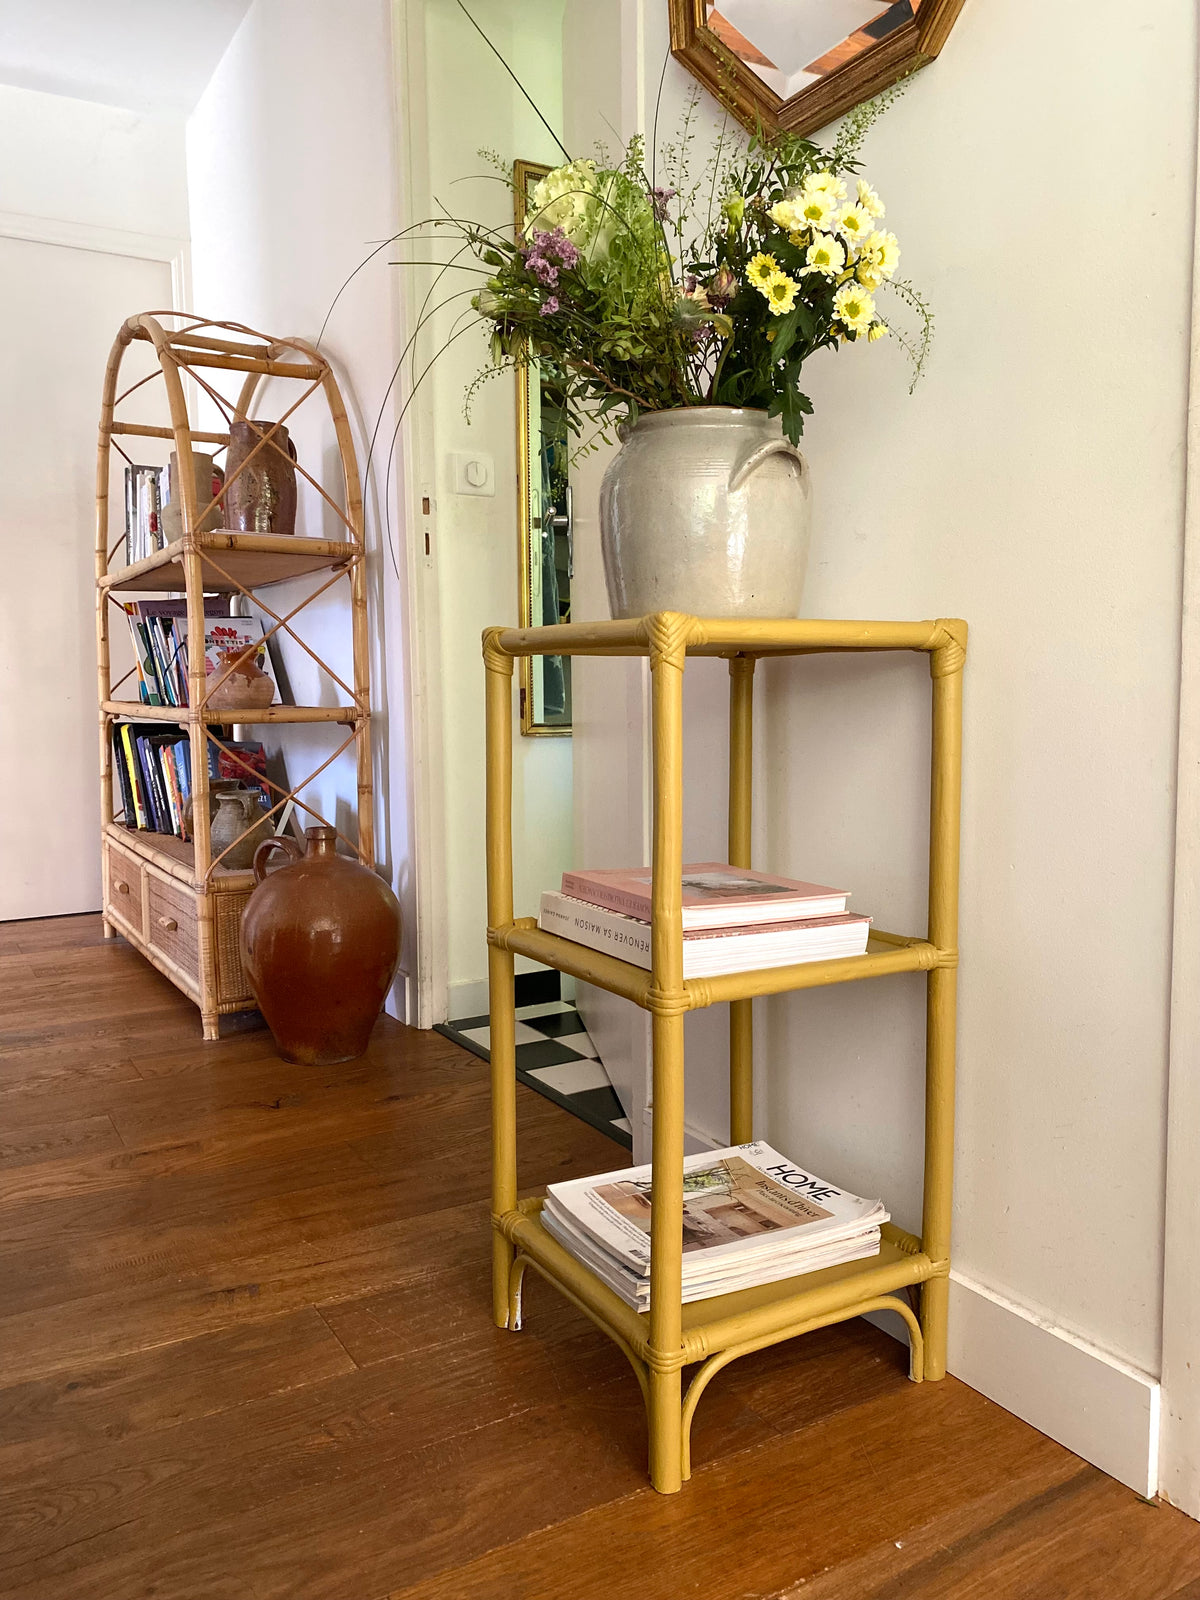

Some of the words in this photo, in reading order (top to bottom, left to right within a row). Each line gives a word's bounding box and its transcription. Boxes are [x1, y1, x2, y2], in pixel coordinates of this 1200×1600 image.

[146, 608, 157, 616] Le
[574, 917, 601, 934] MAISON
[603, 928, 611, 939] SA
[614, 931, 650, 953] RÉNOVER
[766, 1164, 842, 1201] HOME
[755, 1180, 788, 1201] Instants
[787, 1199, 819, 1218] d'hiver
